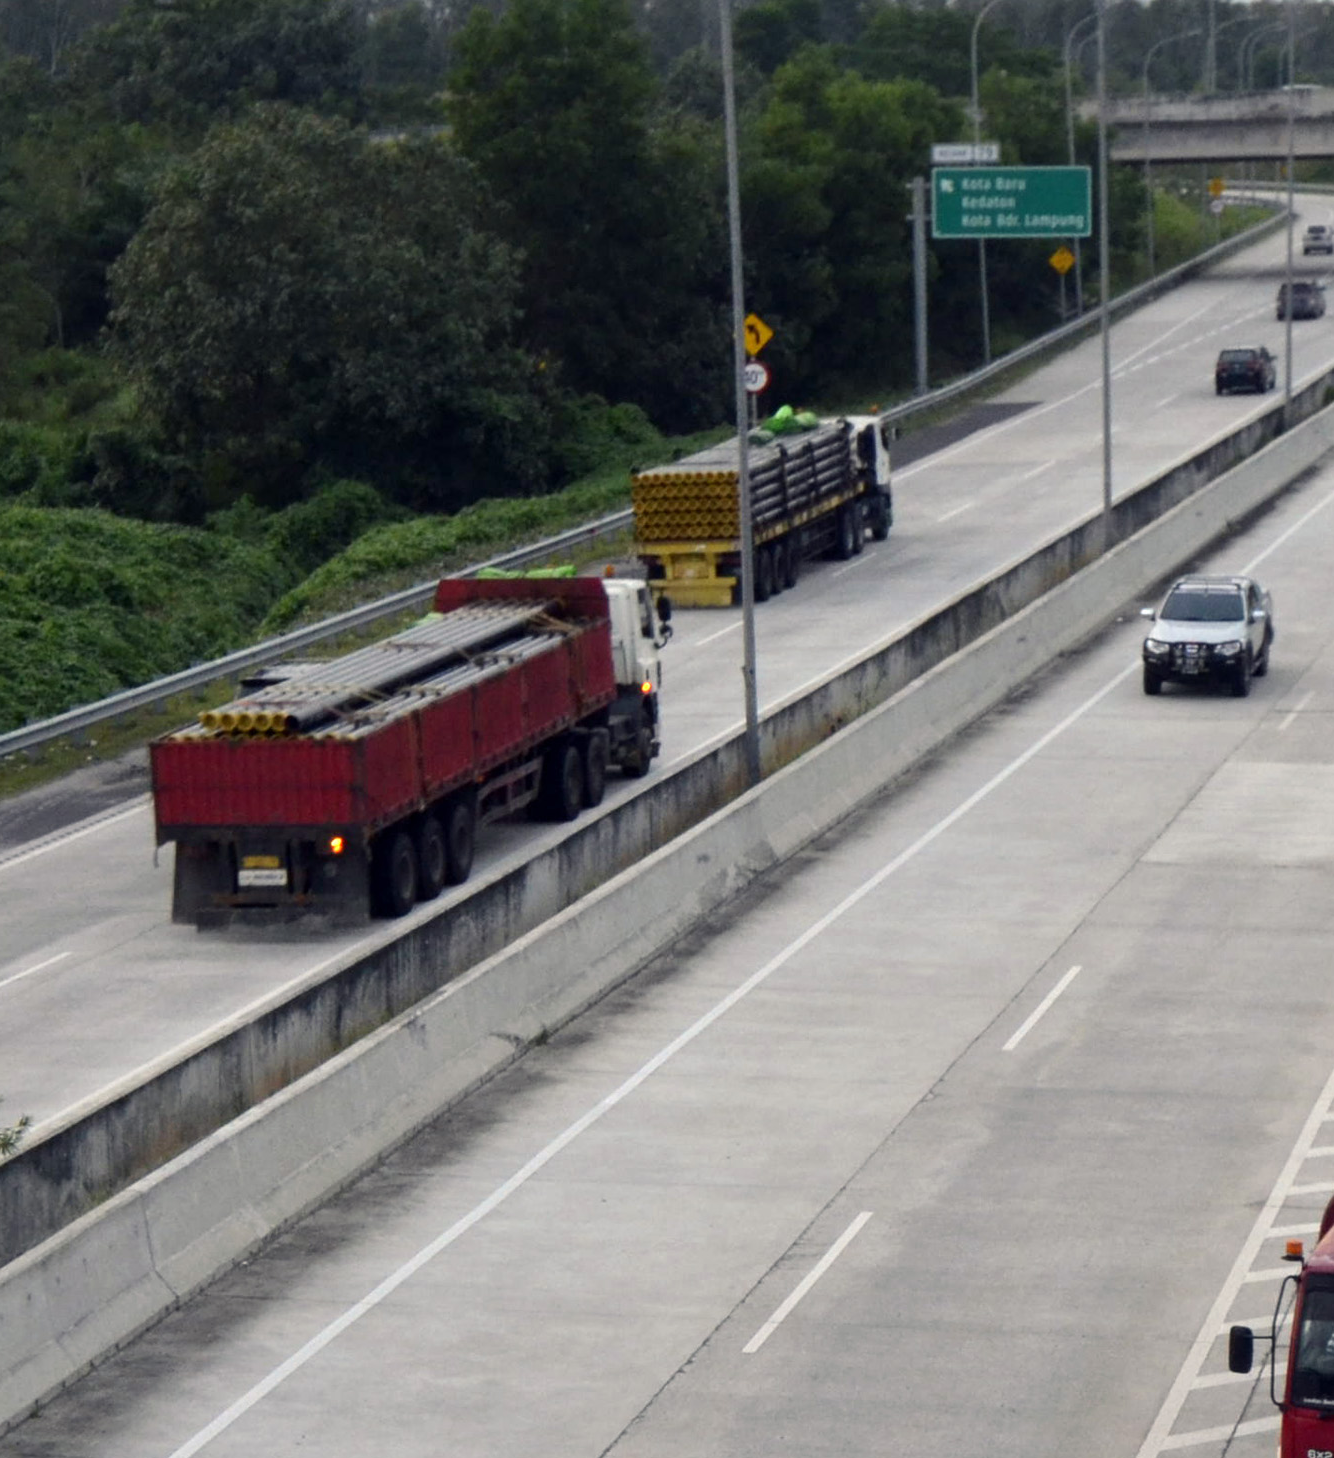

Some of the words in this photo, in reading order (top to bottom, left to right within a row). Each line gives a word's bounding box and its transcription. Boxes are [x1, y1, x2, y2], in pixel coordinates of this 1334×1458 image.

[961, 178, 992, 190] Kota
[995, 177, 1026, 190] Baru
[961, 196, 1016, 208] Kedaton
[961, 214, 992, 227] Kota
[1024, 214, 1085, 229] Lampung
